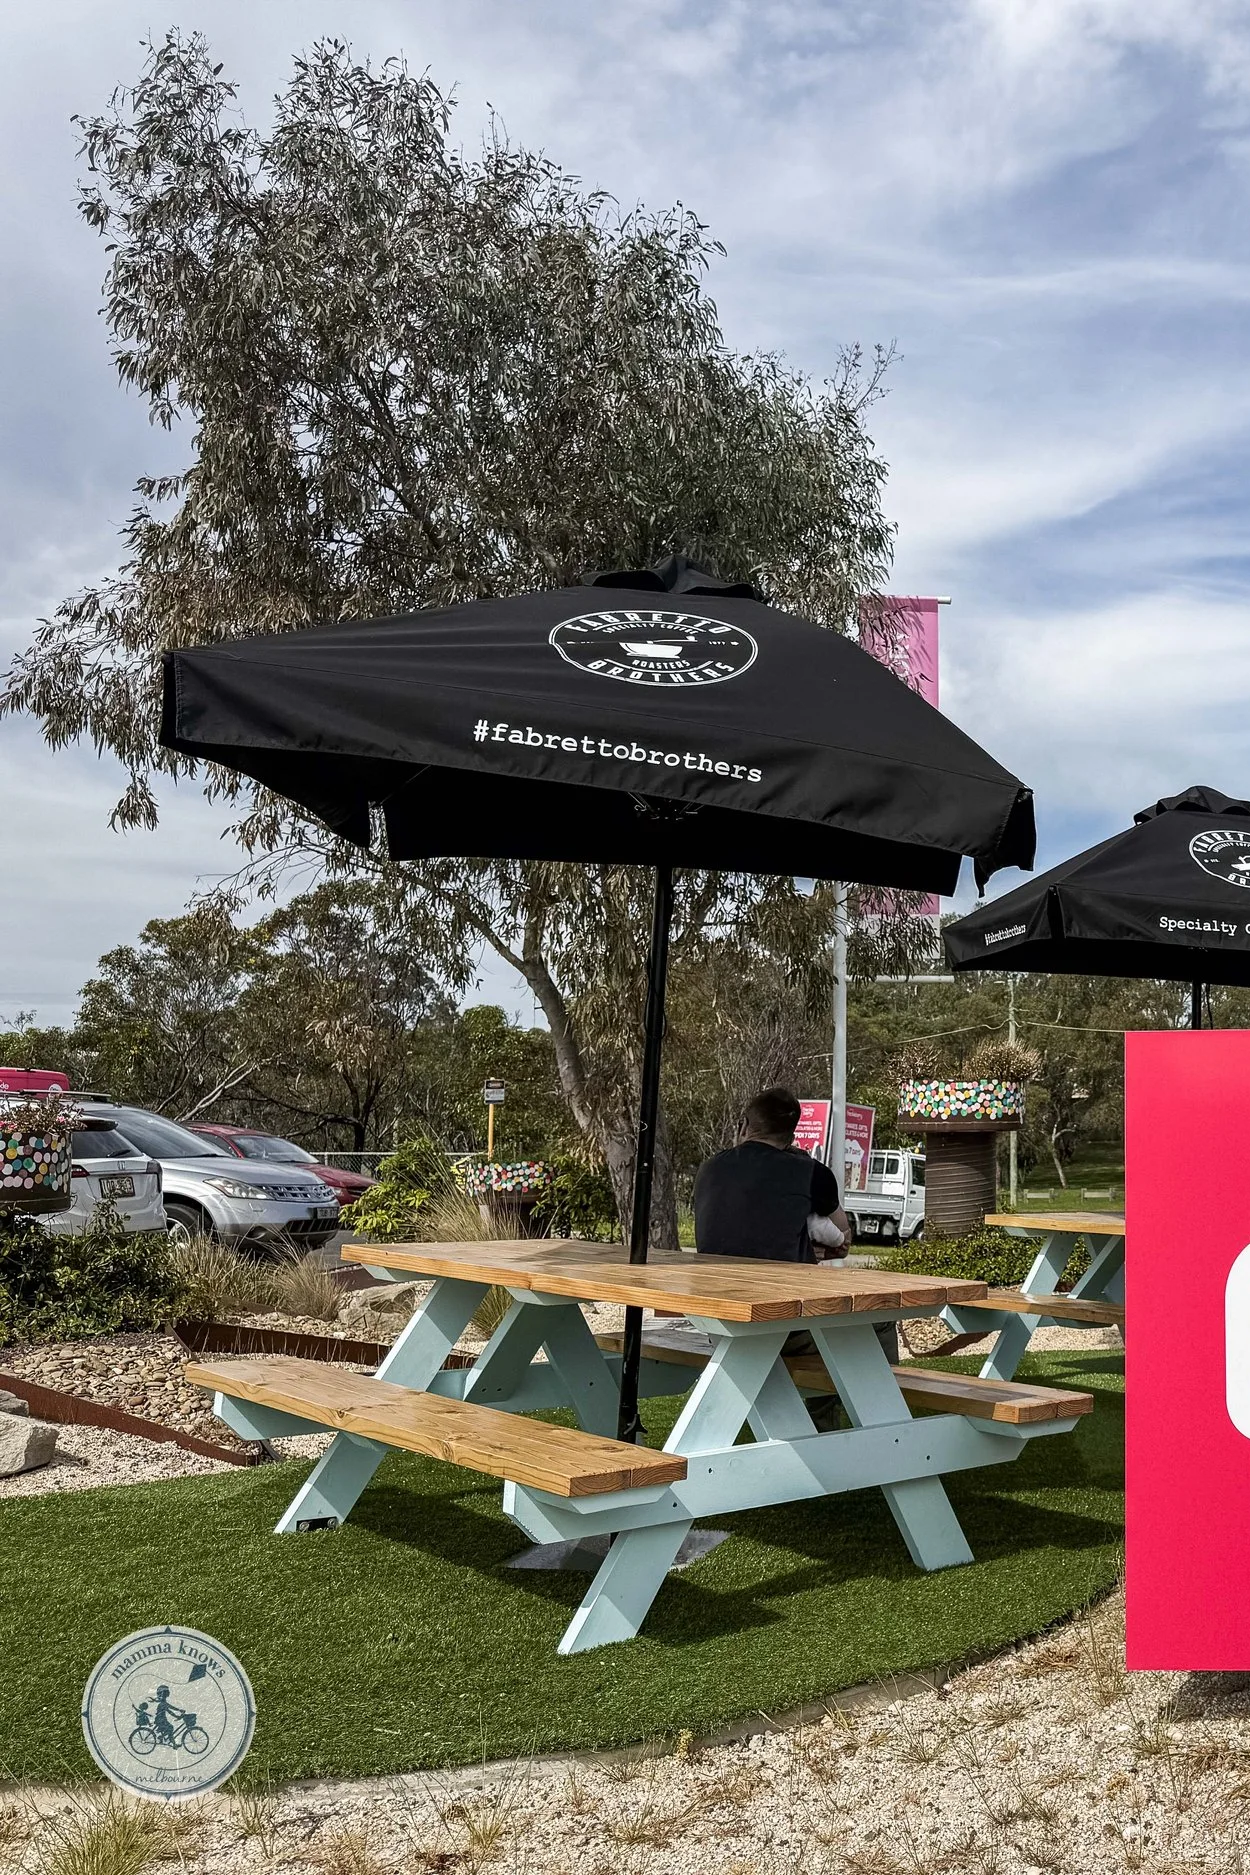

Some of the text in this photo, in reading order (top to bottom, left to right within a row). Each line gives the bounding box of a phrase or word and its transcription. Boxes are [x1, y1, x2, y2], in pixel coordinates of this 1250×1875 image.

[564, 613, 732, 634] FABRETTO
[587, 661, 735, 683] BROTHERS
[631, 659, 691, 669] ROASTERS
[473, 719, 762, 782] #fabrettobrothers
[1159, 916, 1237, 936] Specialty
